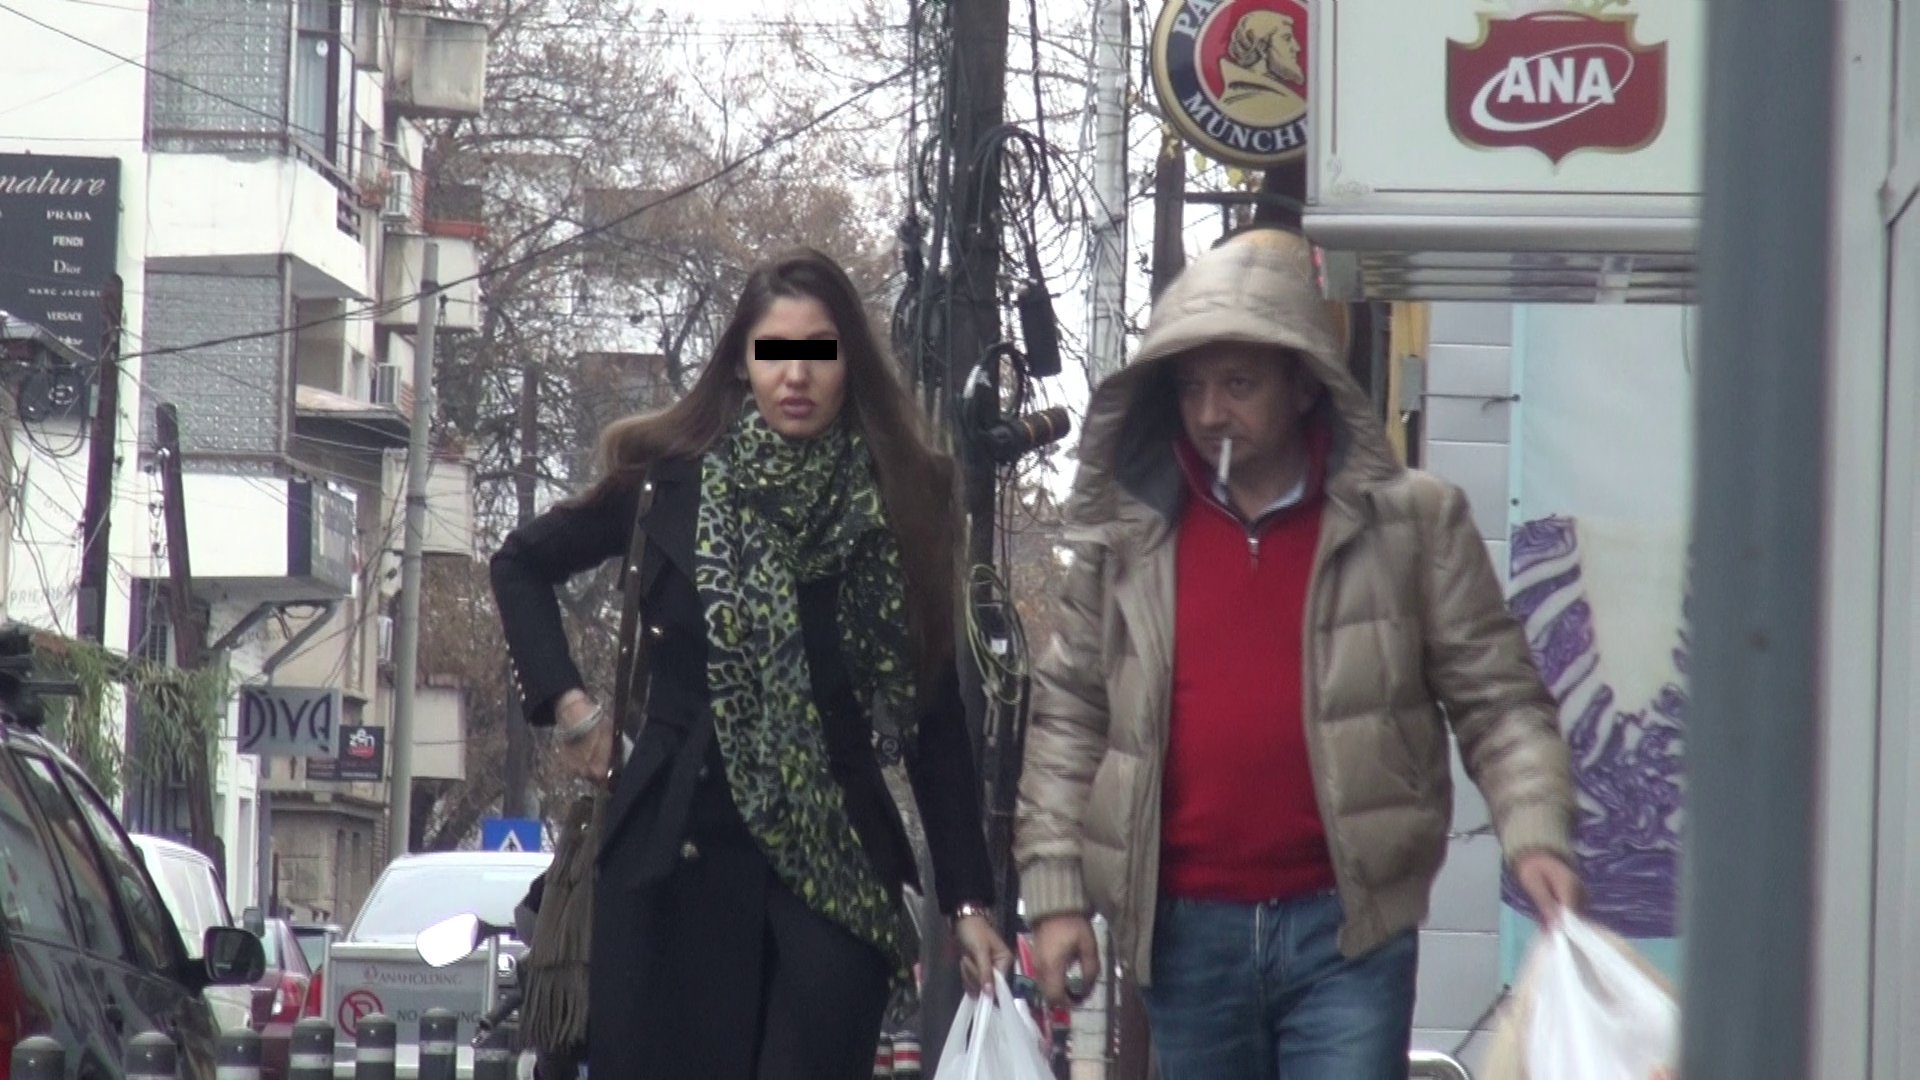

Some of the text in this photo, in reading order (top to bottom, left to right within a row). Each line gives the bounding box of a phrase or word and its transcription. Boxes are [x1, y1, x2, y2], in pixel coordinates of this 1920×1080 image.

[1497, 56, 1616, 104] ANA
[47, 210, 92, 222] PRADA
[53, 236, 84, 247] FENDI
[54, 260, 82, 274] Dior
[28, 288, 57, 296] MARC
[47, 311, 83, 323] VERSACE
[397, 1009, 418, 1022] NO
